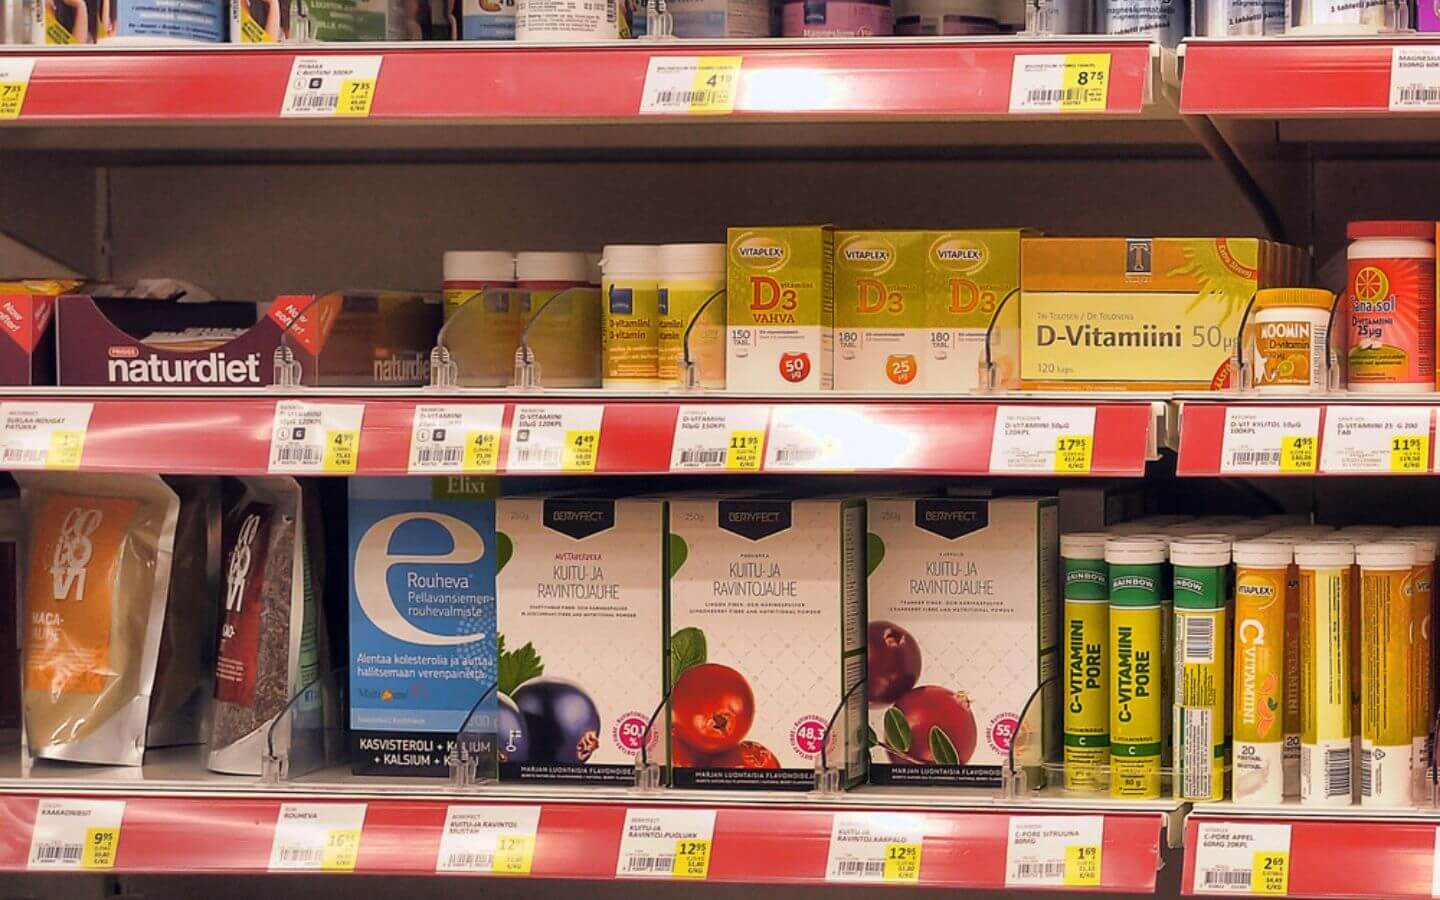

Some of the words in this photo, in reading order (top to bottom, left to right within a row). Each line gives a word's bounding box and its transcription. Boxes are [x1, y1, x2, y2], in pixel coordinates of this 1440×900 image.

[753, 314, 795, 324] VAHVA
[731, 330, 750, 340] 150
[839, 332, 857, 342] 180
[930, 332, 950, 342] 180
[1037, 325, 1181, 347] D-Vitamiini
[108, 353, 260, 383] naturdiet
[1038, 364, 1054, 373] 120
[553, 565, 588, 581] KUITU-
[590, 565, 603, 581] JA
[729, 562, 766, 578] KUITU-
[767, 562, 781, 578] JA
[926, 561, 963, 577] KUITU-
[964, 561, 978, 577] JA
[407, 572, 469, 589] Rouheva
[910, 580, 994, 595] RAVINTOJAUHE
[537, 583, 620, 599] RAVINTOJAUHE
[713, 581, 797, 597] RAVINTOJAUHE
[357, 653, 391, 665] Alentaa
[1070, 620, 1083, 713] C-VITAMIINI
[1086, 643, 1101, 689] PORE
[1118, 626, 1132, 722] C-VITAMIINI
[1136, 651, 1150, 697] PORE
[359, 738, 434, 751] KASVISTEROLI
[384, 753, 431, 766] KALSIUM
